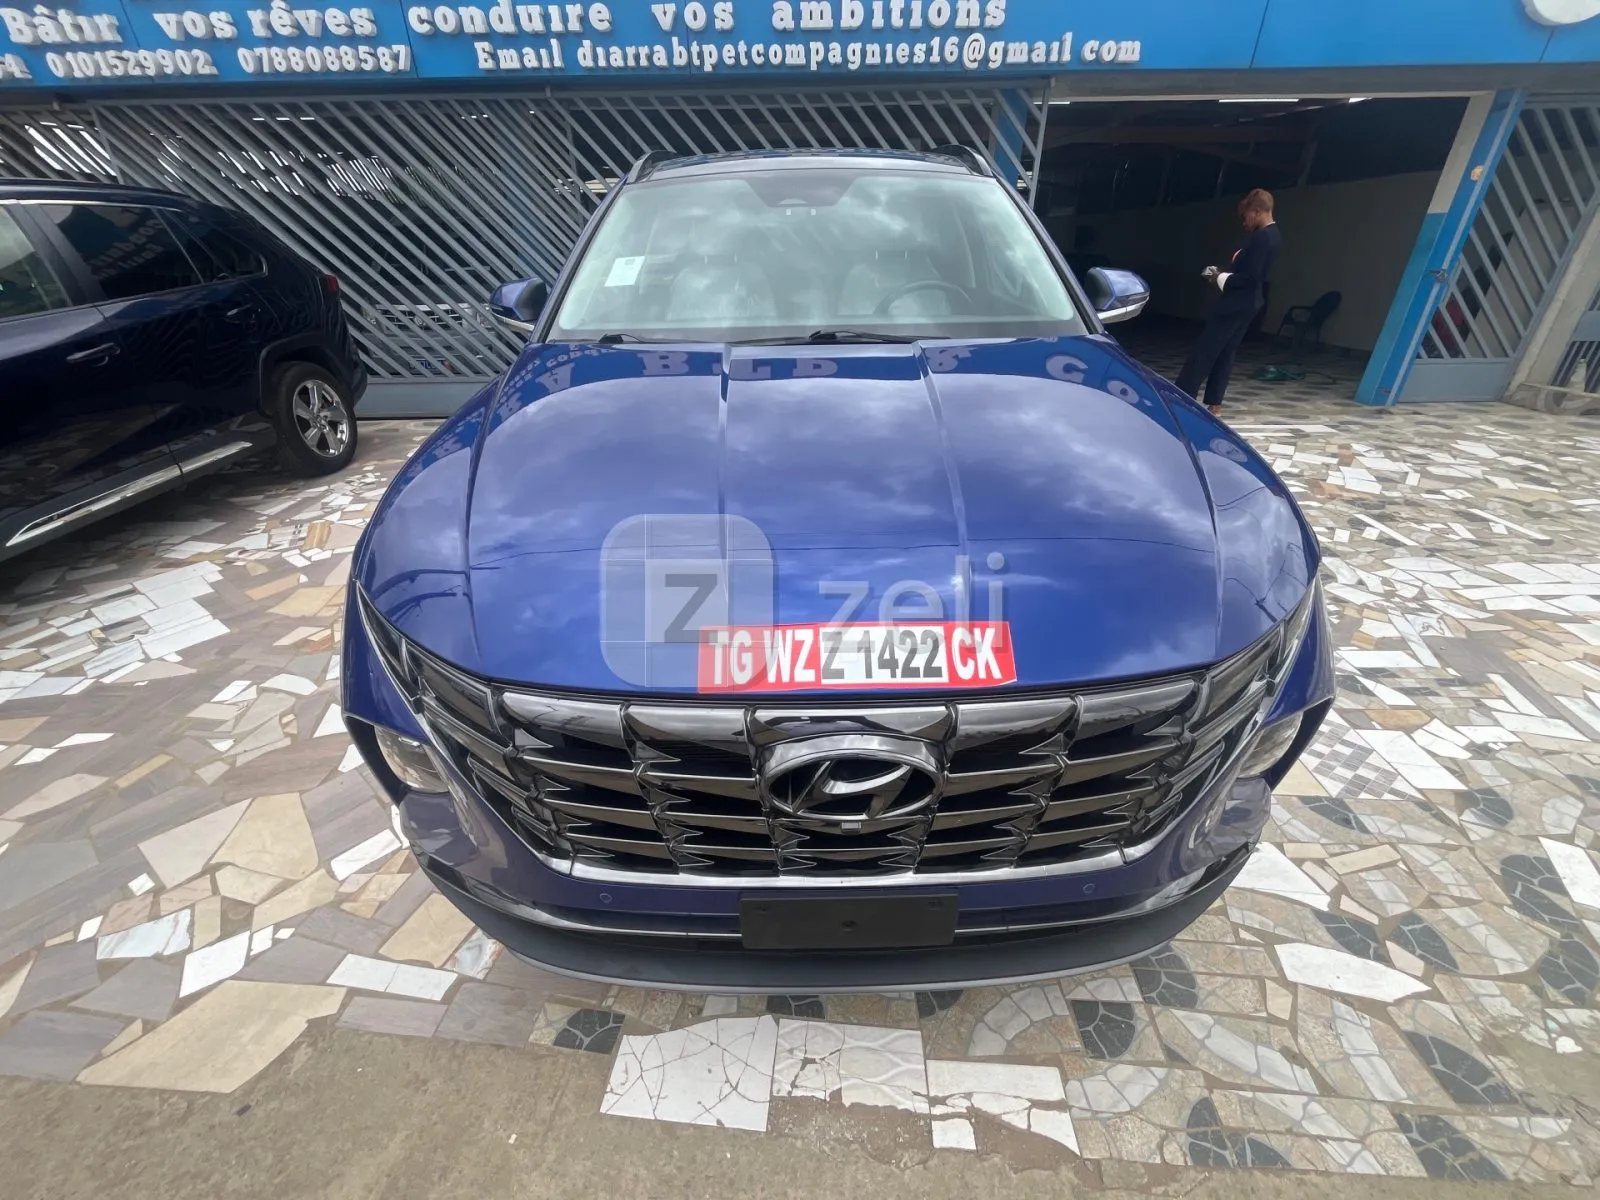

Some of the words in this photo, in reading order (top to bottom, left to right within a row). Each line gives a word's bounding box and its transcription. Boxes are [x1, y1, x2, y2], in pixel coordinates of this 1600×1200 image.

[153, 11, 237, 40] vos
[246, 0, 377, 38] rêves
[651, 1, 734, 32] vos
[46, 48, 218, 79] 0101529902
[237, 44, 410, 74] 0788088587
[1082, 38, 1141, 64] com
[710, 629, 753, 684] TG
[855, 628, 944, 680] 1422
[950, 627, 1002, 682] CK
